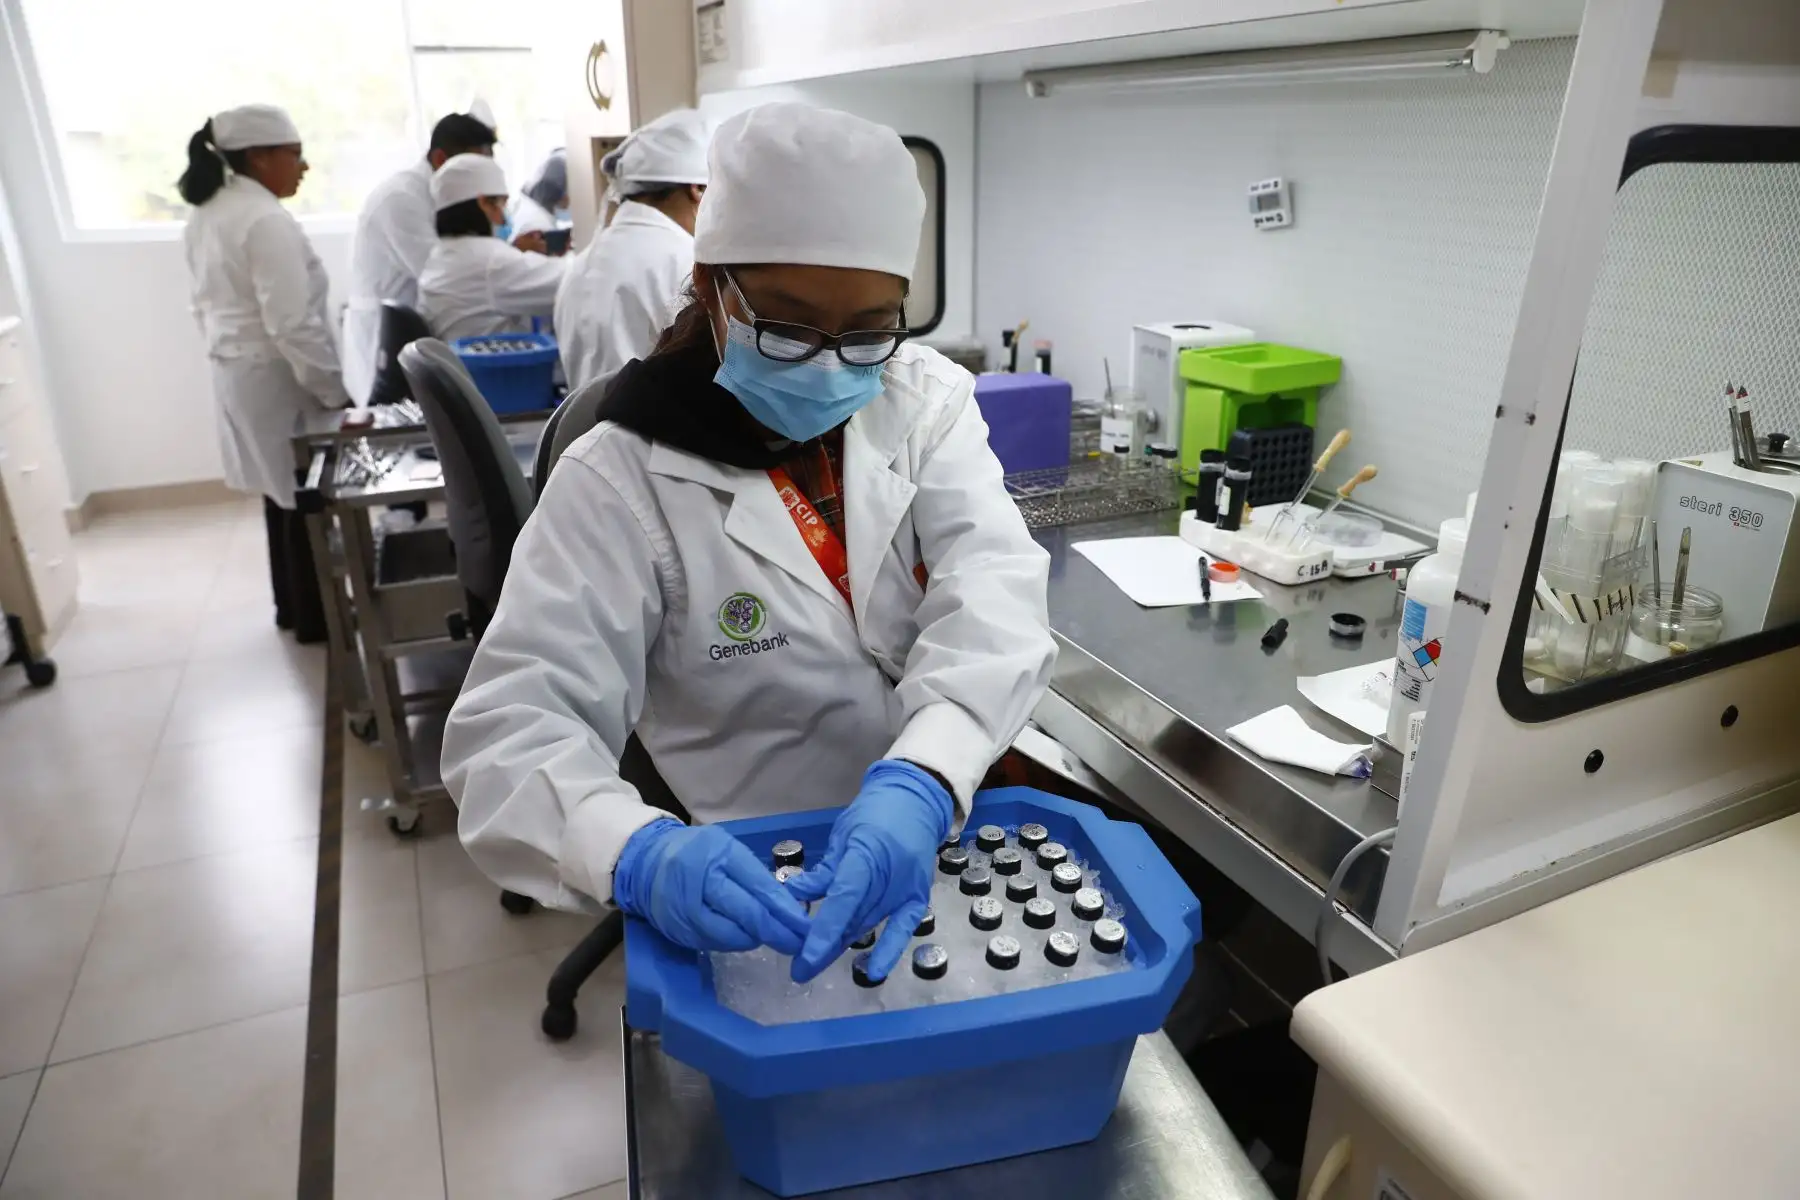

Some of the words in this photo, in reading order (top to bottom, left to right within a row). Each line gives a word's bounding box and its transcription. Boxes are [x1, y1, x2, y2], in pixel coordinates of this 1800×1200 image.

[796, 503, 818, 526] CIP
[1679, 495, 1722, 516] steri
[1728, 506, 1764, 528] 350
[709, 631, 790, 661] Genebank
